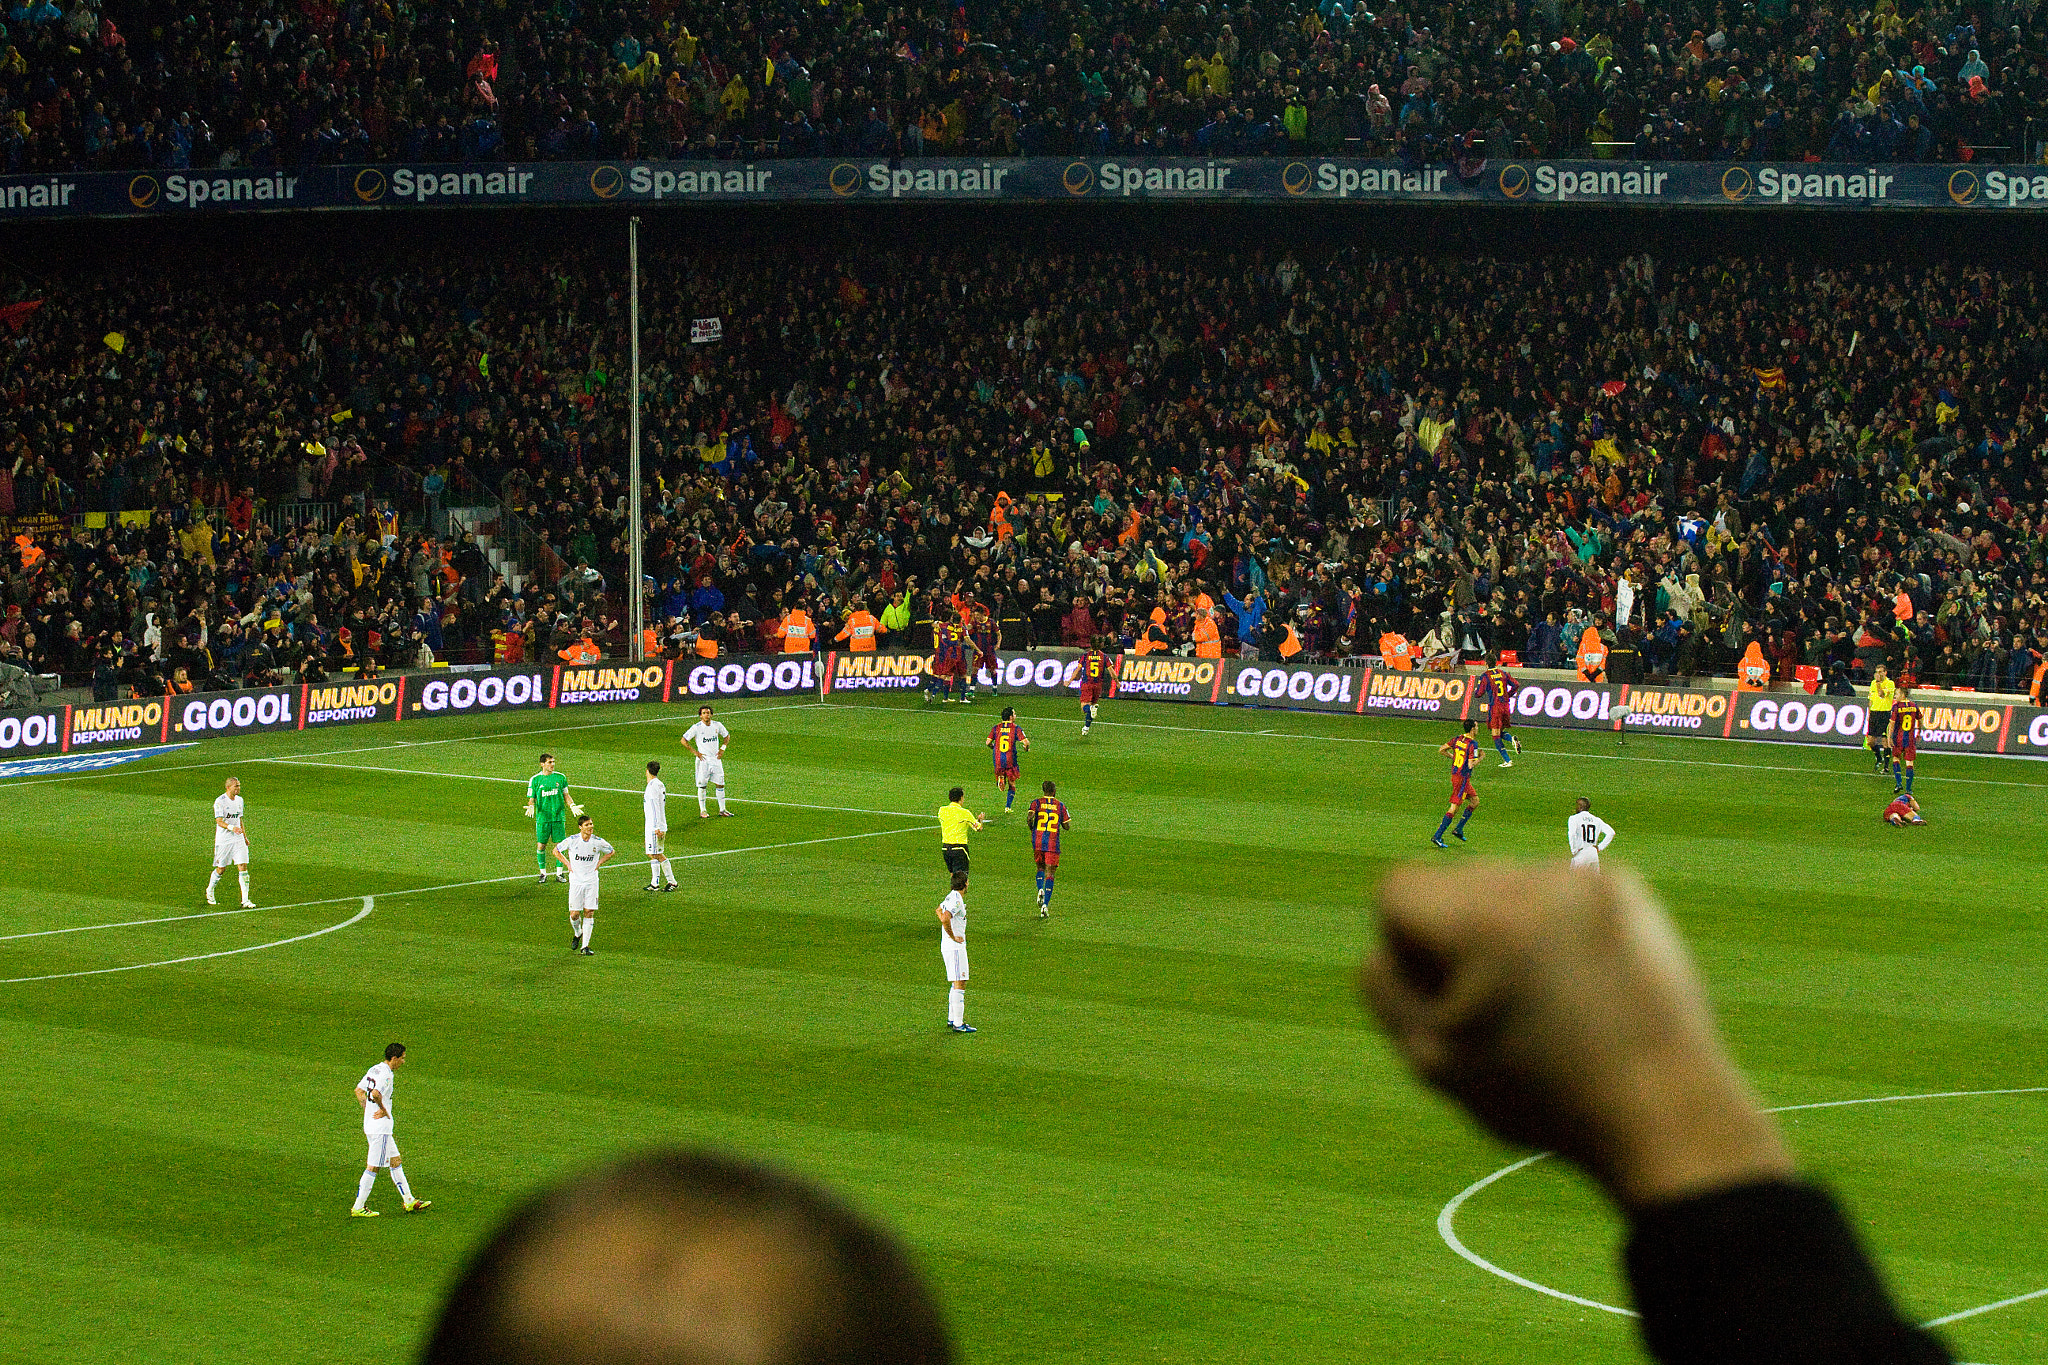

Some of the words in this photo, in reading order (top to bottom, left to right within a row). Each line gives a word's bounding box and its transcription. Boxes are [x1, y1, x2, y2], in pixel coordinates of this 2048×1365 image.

[166, 173, 299, 208] Spanair
[393, 166, 534, 201] Spanair
[630, 164, 773, 199] Spanair
[868, 162, 1009, 198] Spanair
[1100, 162, 1231, 197] Spanair
[1316, 162, 1448, 197] Spanair
[1535, 165, 1669, 202] Spanair
[1757, 167, 1894, 206] Spanair
[562, 665, 663, 691] MUNDO
[1090, 661, 1099, 678] 5
[1121, 659, 1215, 684] MUNDO
[834, 675, 920, 689] DEPORTIVO
[1119, 681, 1191, 695] DEPORTIVO
[1370, 674, 1465, 701] MUNDO
[1494, 680, 1504, 697] 3
[309, 682, 397, 708] MUNDO
[560, 687, 640, 704] DEPORTIVO
[1367, 695, 1441, 712] DEPORTIVO
[1629, 690, 1727, 718] MUNDO
[73, 702, 162, 731] MUNDO
[308, 706, 377, 723] DEPORTIVO
[1625, 712, 1702, 729] DEPORTIVO
[1901, 714, 1913, 732] 8
[72, 726, 141, 745] DEPORTIVO
[999, 735, 1010, 753] 6
[1453, 747, 1466, 769] 16
[1036, 811, 1060, 833] 22
[1581, 823, 1596, 844] 10
[574, 853, 595, 862] bwin
